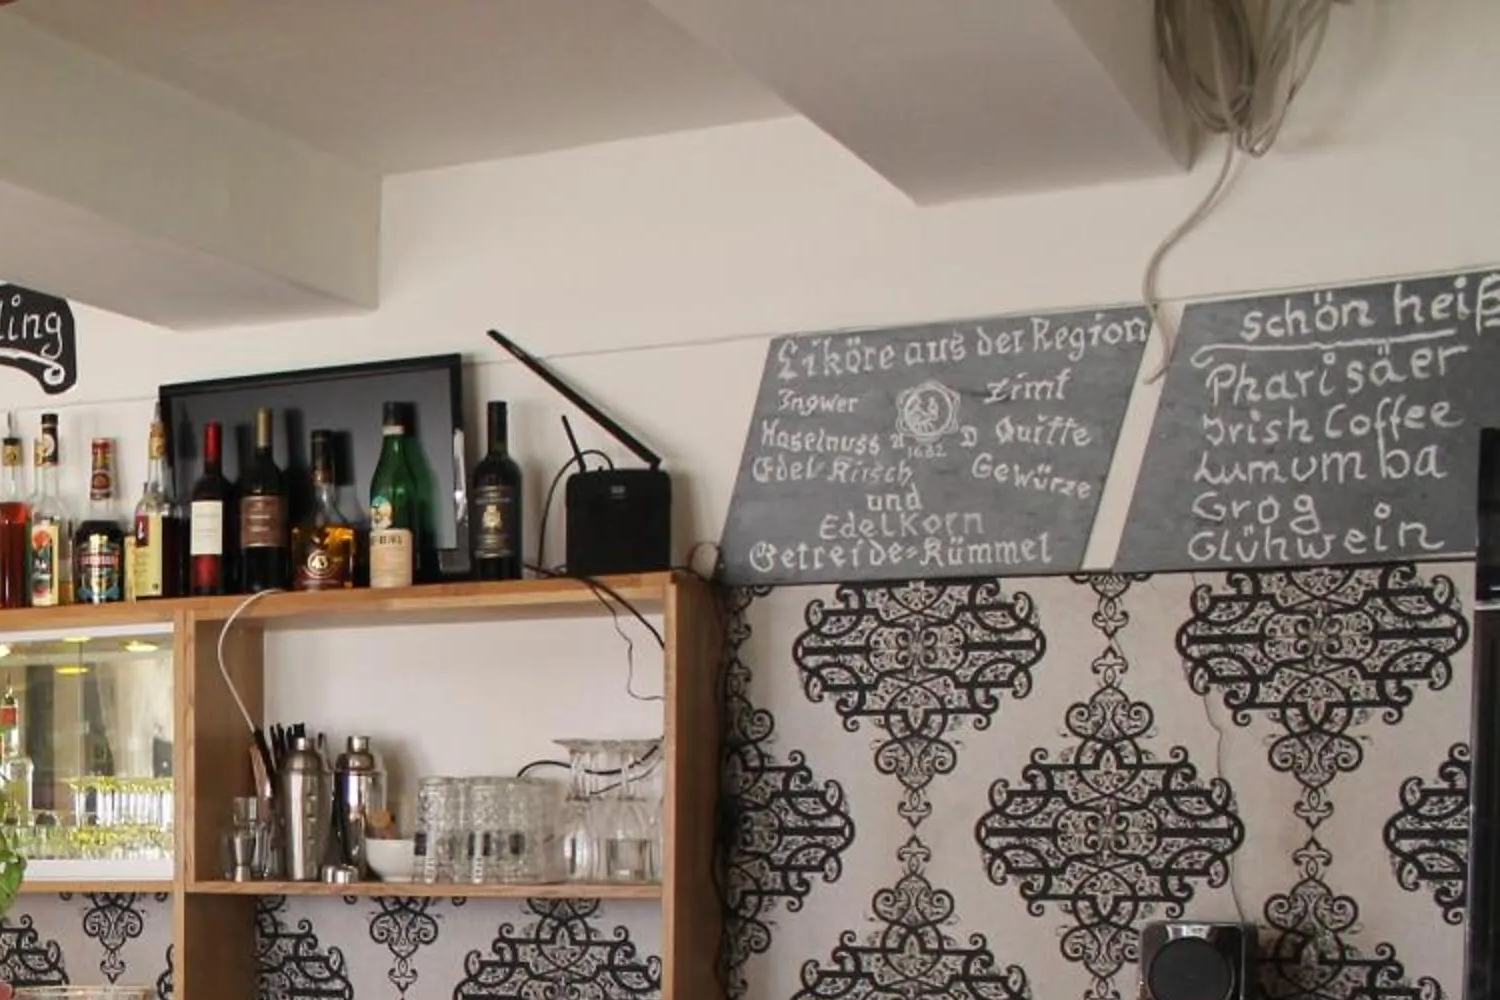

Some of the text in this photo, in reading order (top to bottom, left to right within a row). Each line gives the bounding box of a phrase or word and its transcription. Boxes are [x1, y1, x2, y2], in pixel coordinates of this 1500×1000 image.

[903, 330, 967, 367] aus
[975, 325, 1026, 356] der
[1029, 312, 1148, 363] Region
[1204, 342, 1470, 405] Pharisäer
[759, 417, 882, 457] Haselnuss
[994, 413, 1094, 448] Quitte
[1202, 396, 1465, 448] Irish Coffee
[970, 452, 1093, 500] Gewürze
[1192, 443, 1449, 484] Lumumba
[865, 481, 924, 512] und
[1191, 490, 1323, 536] Grog
[1186, 501, 1448, 563] Glühwein
